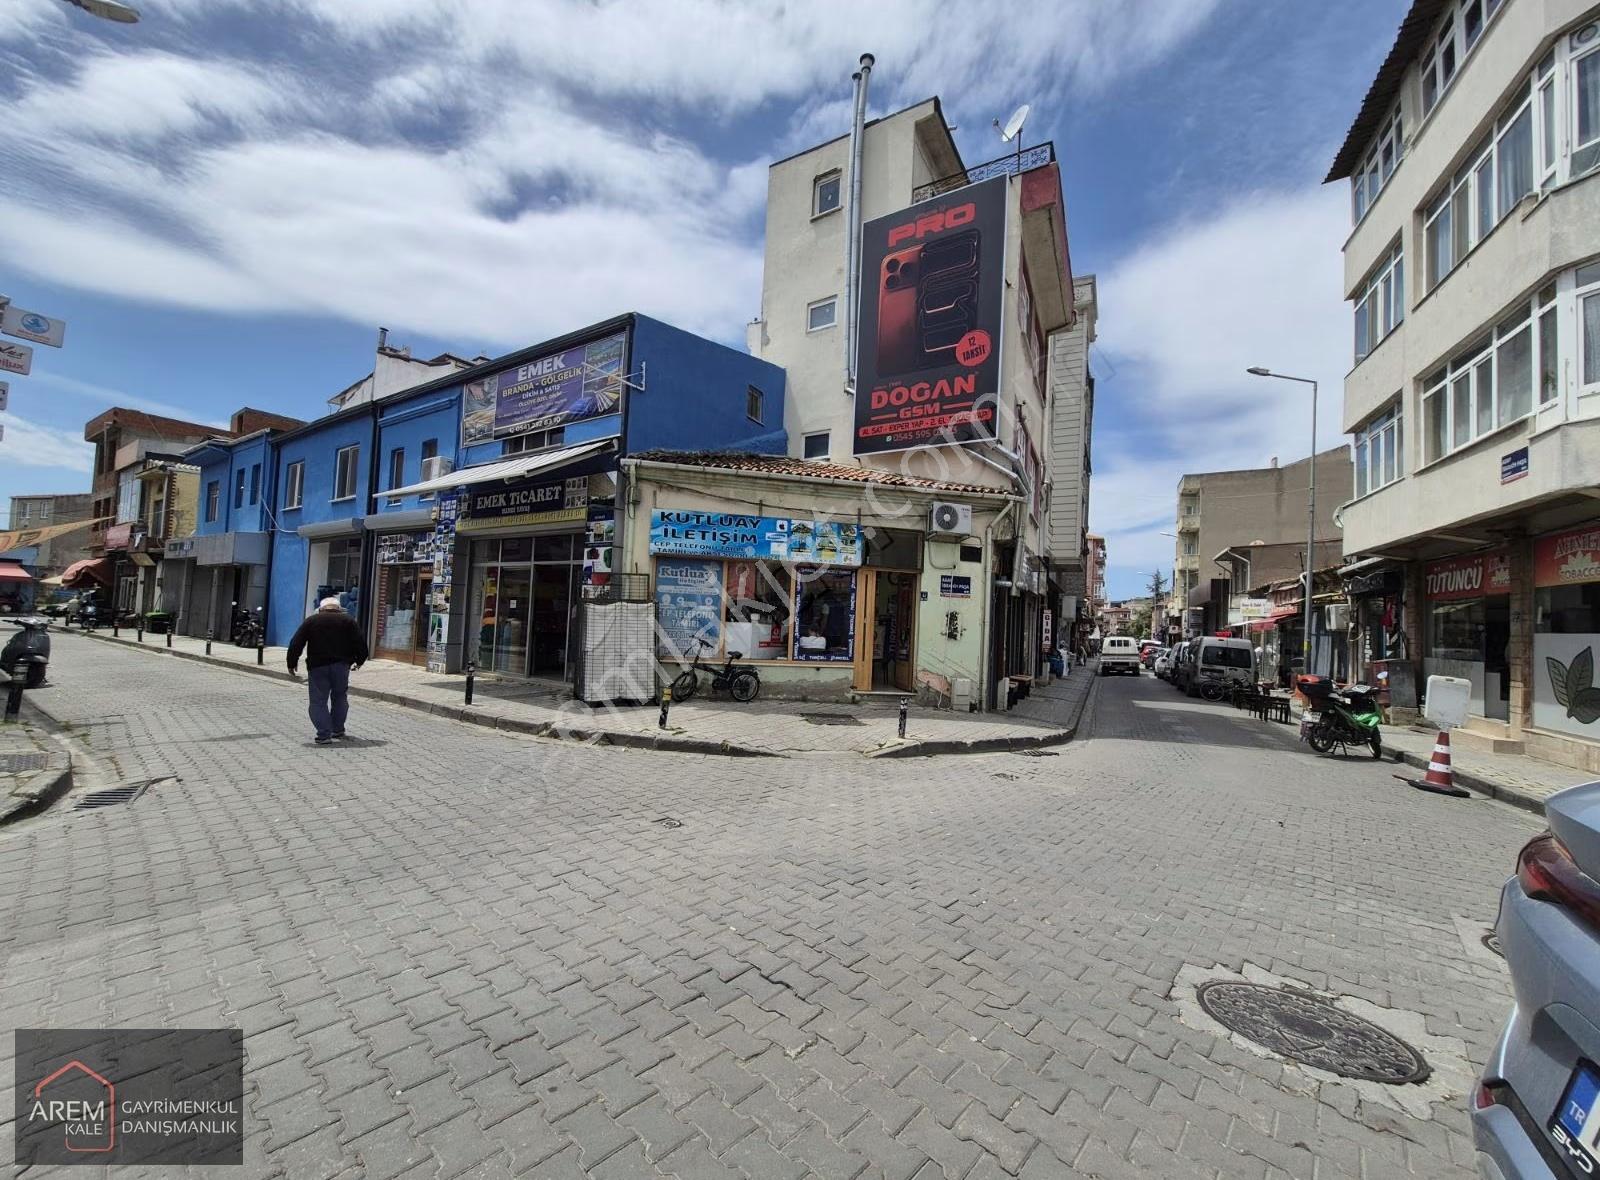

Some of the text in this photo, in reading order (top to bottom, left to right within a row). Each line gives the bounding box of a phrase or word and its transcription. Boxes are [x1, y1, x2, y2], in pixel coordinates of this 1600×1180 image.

[888, 202, 976, 248] PRO
[967, 336, 976, 346] 12
[517, 354, 566, 382] EMEK
[502, 383, 535, 397] BRANDA
[540, 366, 583, 387] GÖLGELİK
[899, 402, 940, 419] GSM
[872, 426, 883, 434] SAT
[889, 422, 910, 433] EXPER
[911, 420, 924, 429] YAP
[476, 494, 507, 510] EMEK
[660, 511, 761, 529] KUTLUAY
[662, 524, 758, 545] İLETİŞİM
[673, 542, 718, 551] TELEFONU
[1426, 559, 1483, 595] TÜTÜNCÜ
[1569, 1100, 1587, 1126] TR
